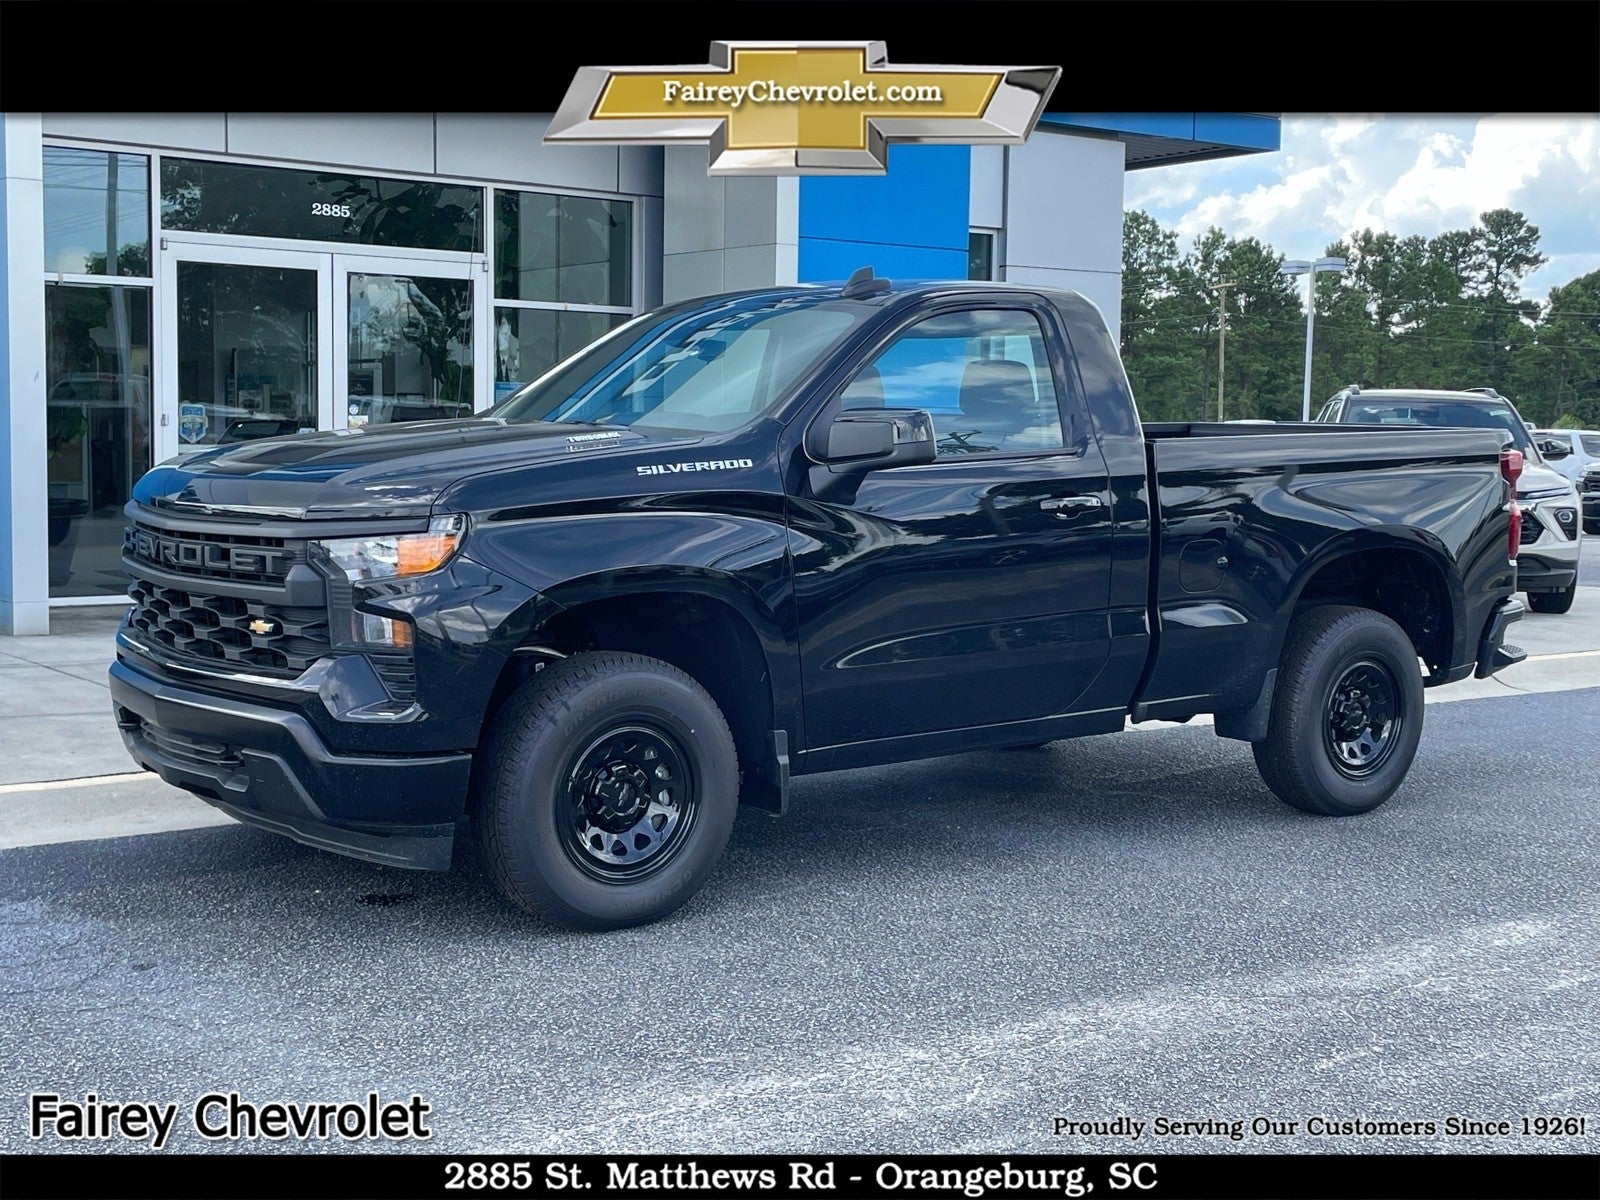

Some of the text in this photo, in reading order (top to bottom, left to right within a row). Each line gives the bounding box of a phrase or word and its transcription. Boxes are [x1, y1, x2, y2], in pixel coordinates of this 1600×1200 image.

[311, 202, 351, 218] 2885
[636, 458, 753, 476] SILVERADO
[124, 526, 283, 573] CHEVROLET
